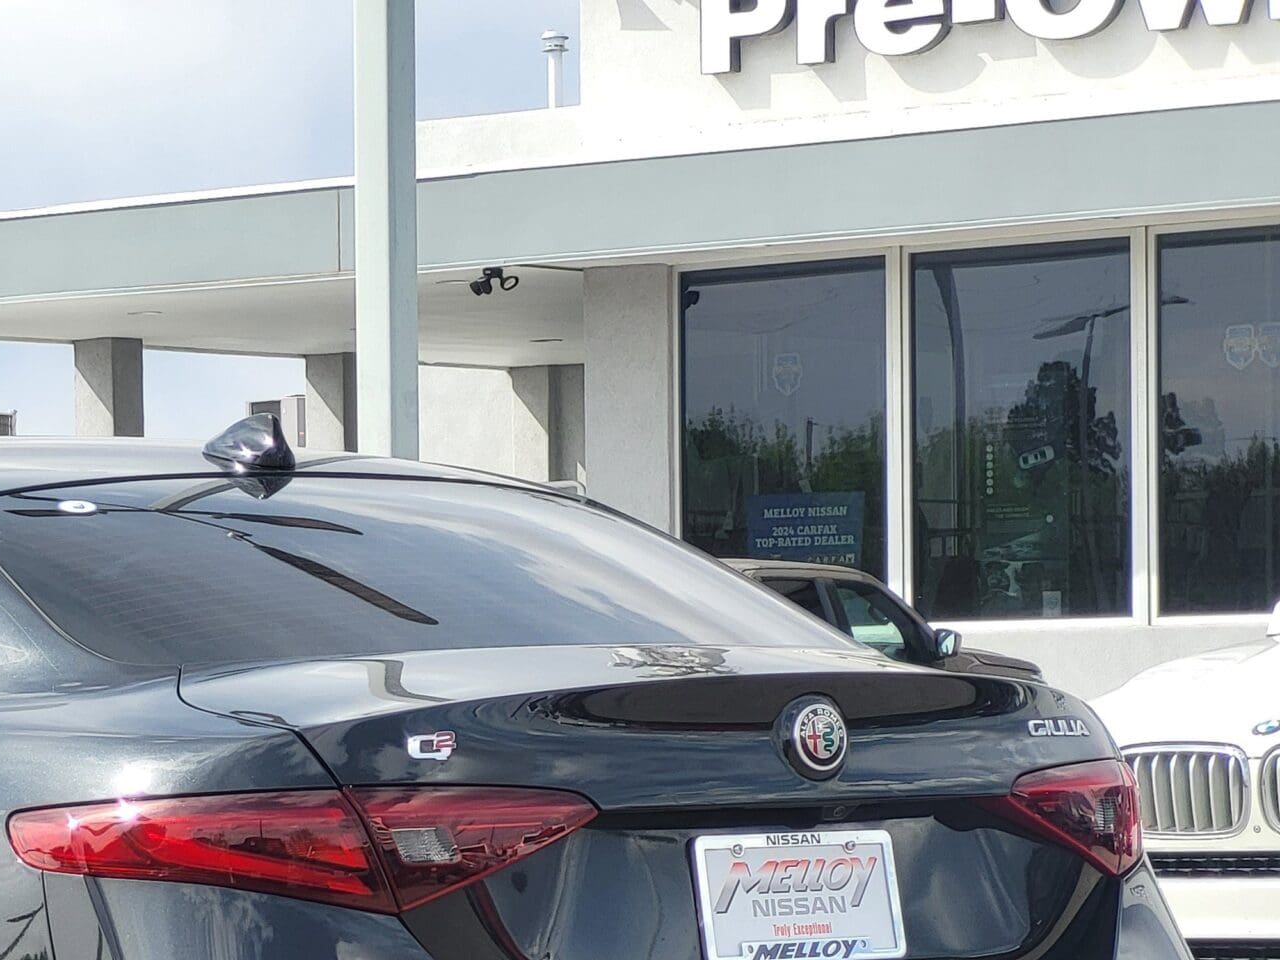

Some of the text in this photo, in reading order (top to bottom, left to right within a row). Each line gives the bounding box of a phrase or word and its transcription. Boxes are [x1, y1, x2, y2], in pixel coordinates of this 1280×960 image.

[701, 0, 1280, 74] Pre-
[763, 506, 848, 518] MELLOY NISSAN
[772, 524, 838, 536] 2024 CARFAX
[755, 534, 855, 548] TOP-RATED DEALER
[1027, 719, 1091, 736] GIULIA
[766, 834, 821, 846] NISSAN
[715, 857, 877, 915] MELLOY
[752, 895, 846, 918] NISSAN
[773, 922, 833, 937] Truly Exceptional
